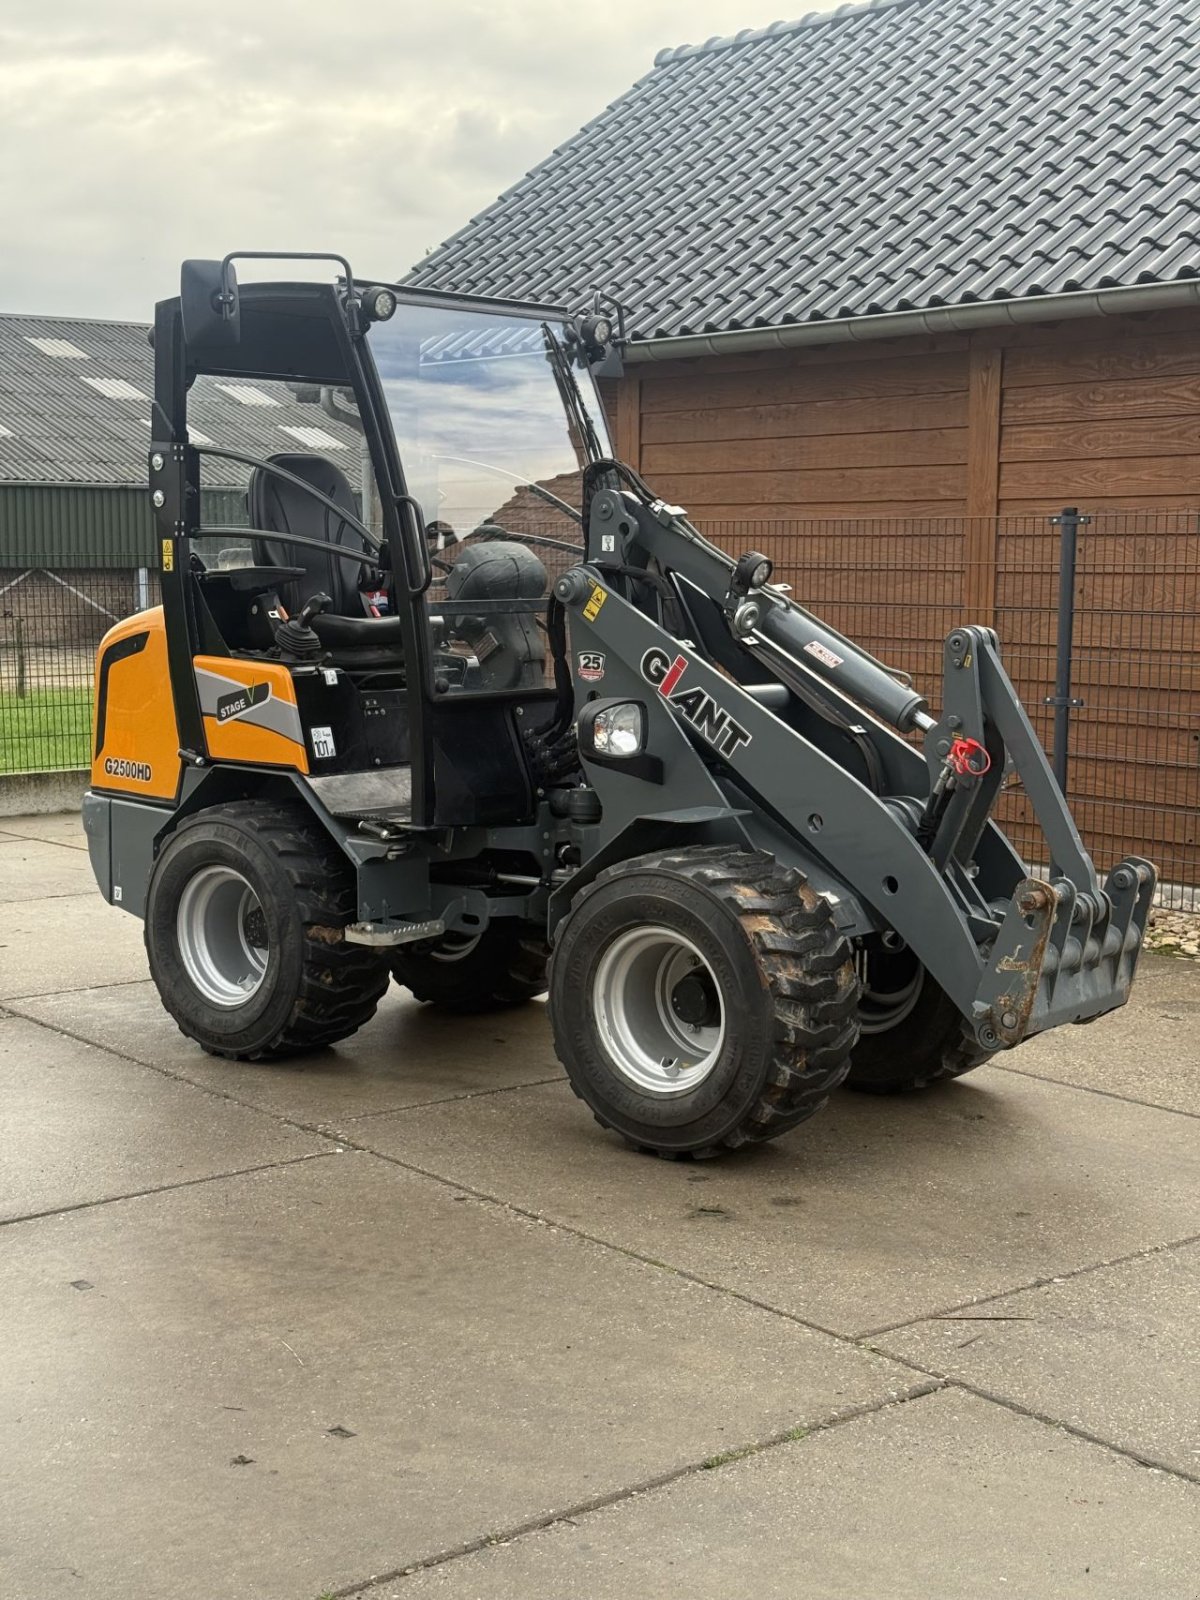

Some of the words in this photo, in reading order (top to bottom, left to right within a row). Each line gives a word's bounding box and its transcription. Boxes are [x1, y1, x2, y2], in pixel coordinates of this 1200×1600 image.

[582, 655, 601, 670] 25
[220, 698, 247, 718] STAGE
[314, 740, 330, 757] 101
[104, 757, 152, 782] G2500HD
